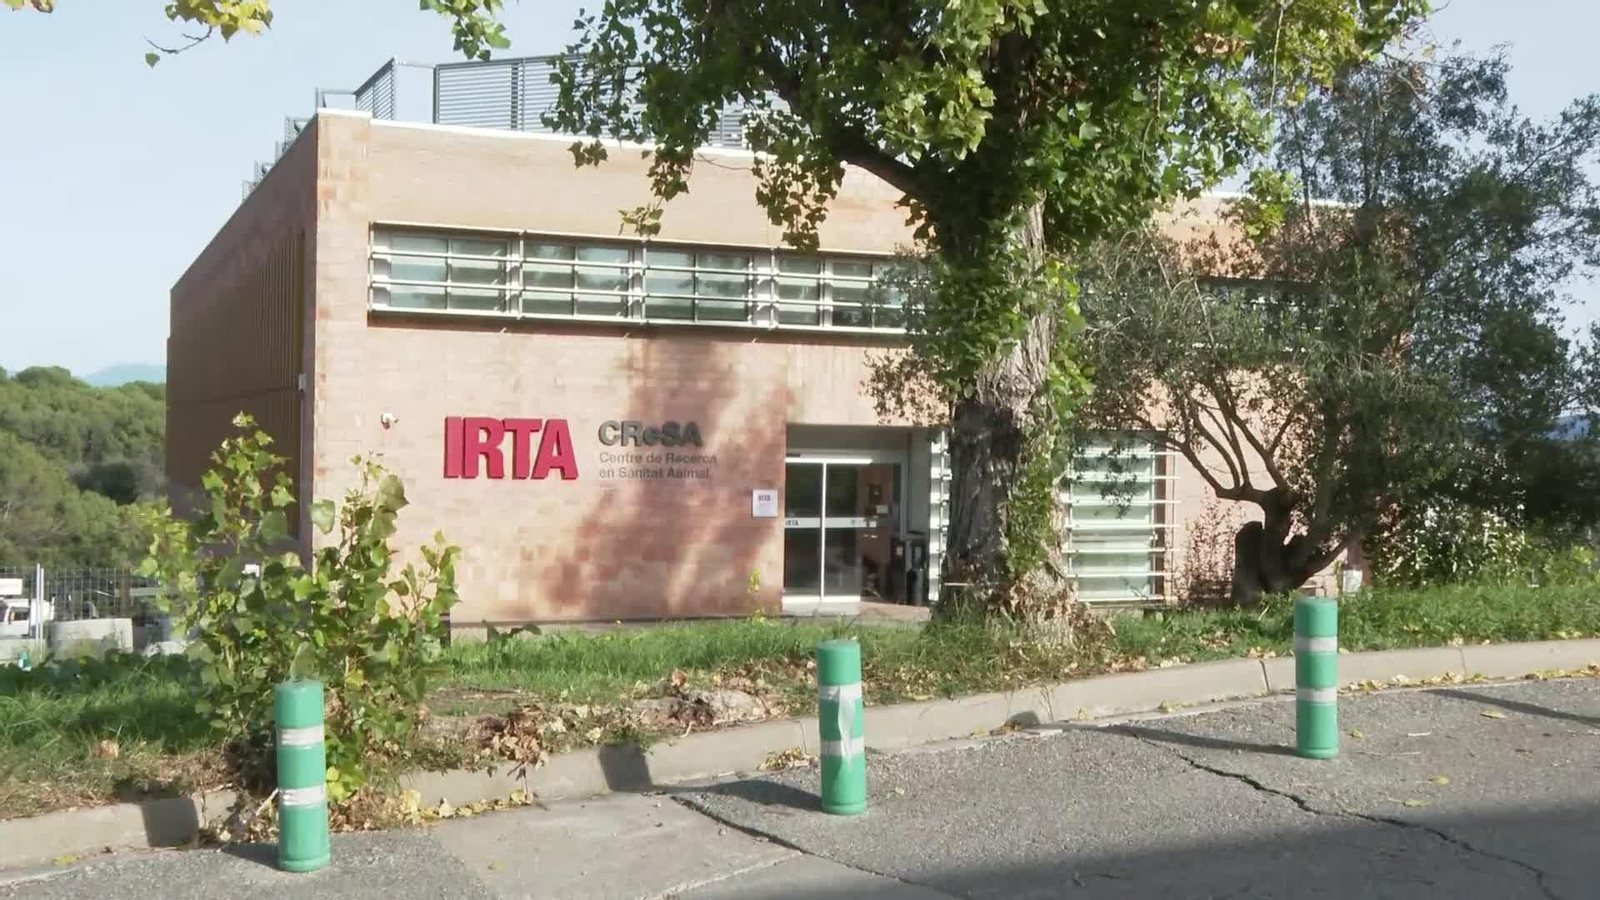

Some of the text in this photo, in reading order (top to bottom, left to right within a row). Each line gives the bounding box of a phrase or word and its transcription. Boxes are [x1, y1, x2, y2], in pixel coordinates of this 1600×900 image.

[598, 420, 703, 447] CReSA
[443, 416, 578, 480] IRTA
[599, 452, 718, 465] Centre de Recerca
[599, 467, 710, 479] en Sanitat Animal
